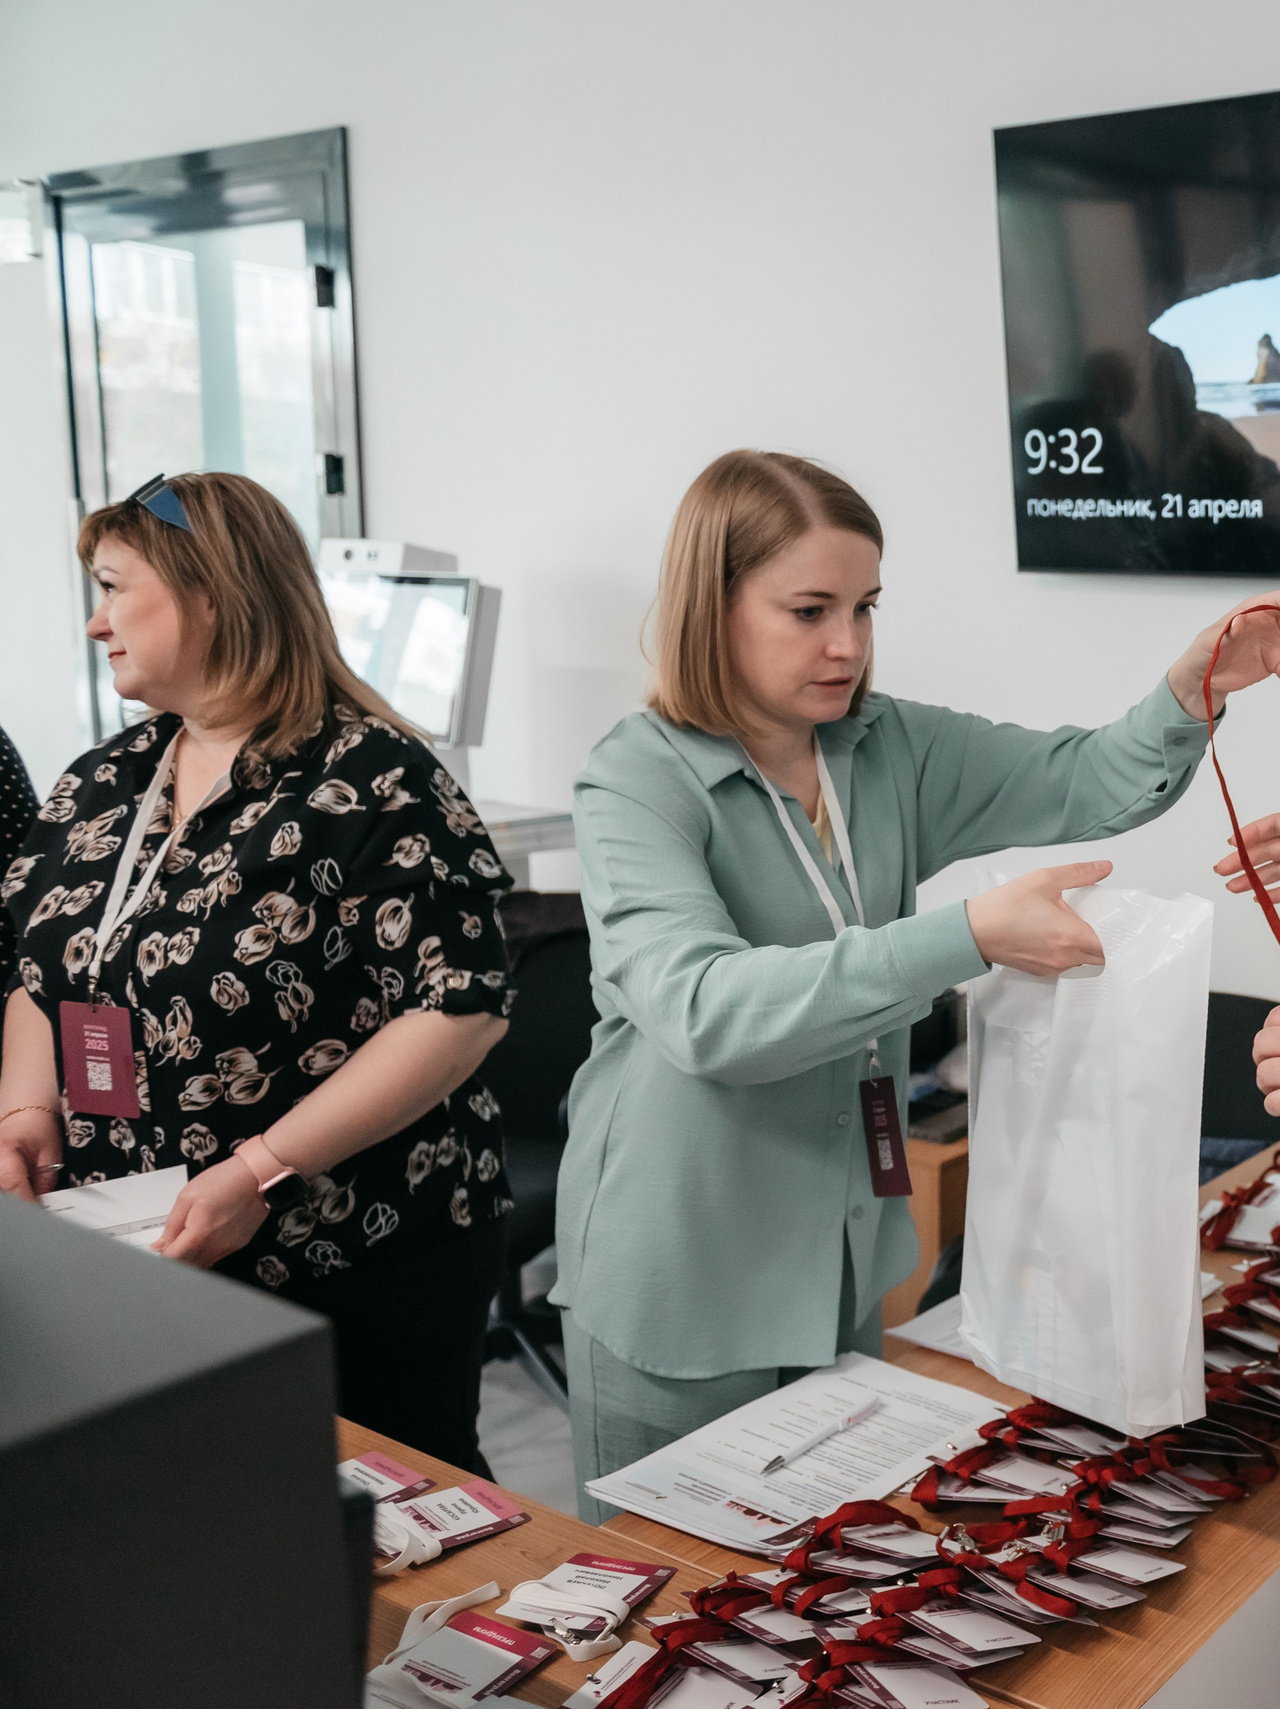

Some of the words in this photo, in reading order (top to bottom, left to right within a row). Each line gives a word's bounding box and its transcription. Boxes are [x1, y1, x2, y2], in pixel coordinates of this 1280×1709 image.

[1024, 427, 1104, 475] 9:32
[1027, 497, 1156, 521] понедельник,
[1161, 493, 1182, 518] 21
[1187, 498, 1263, 524] апреля
